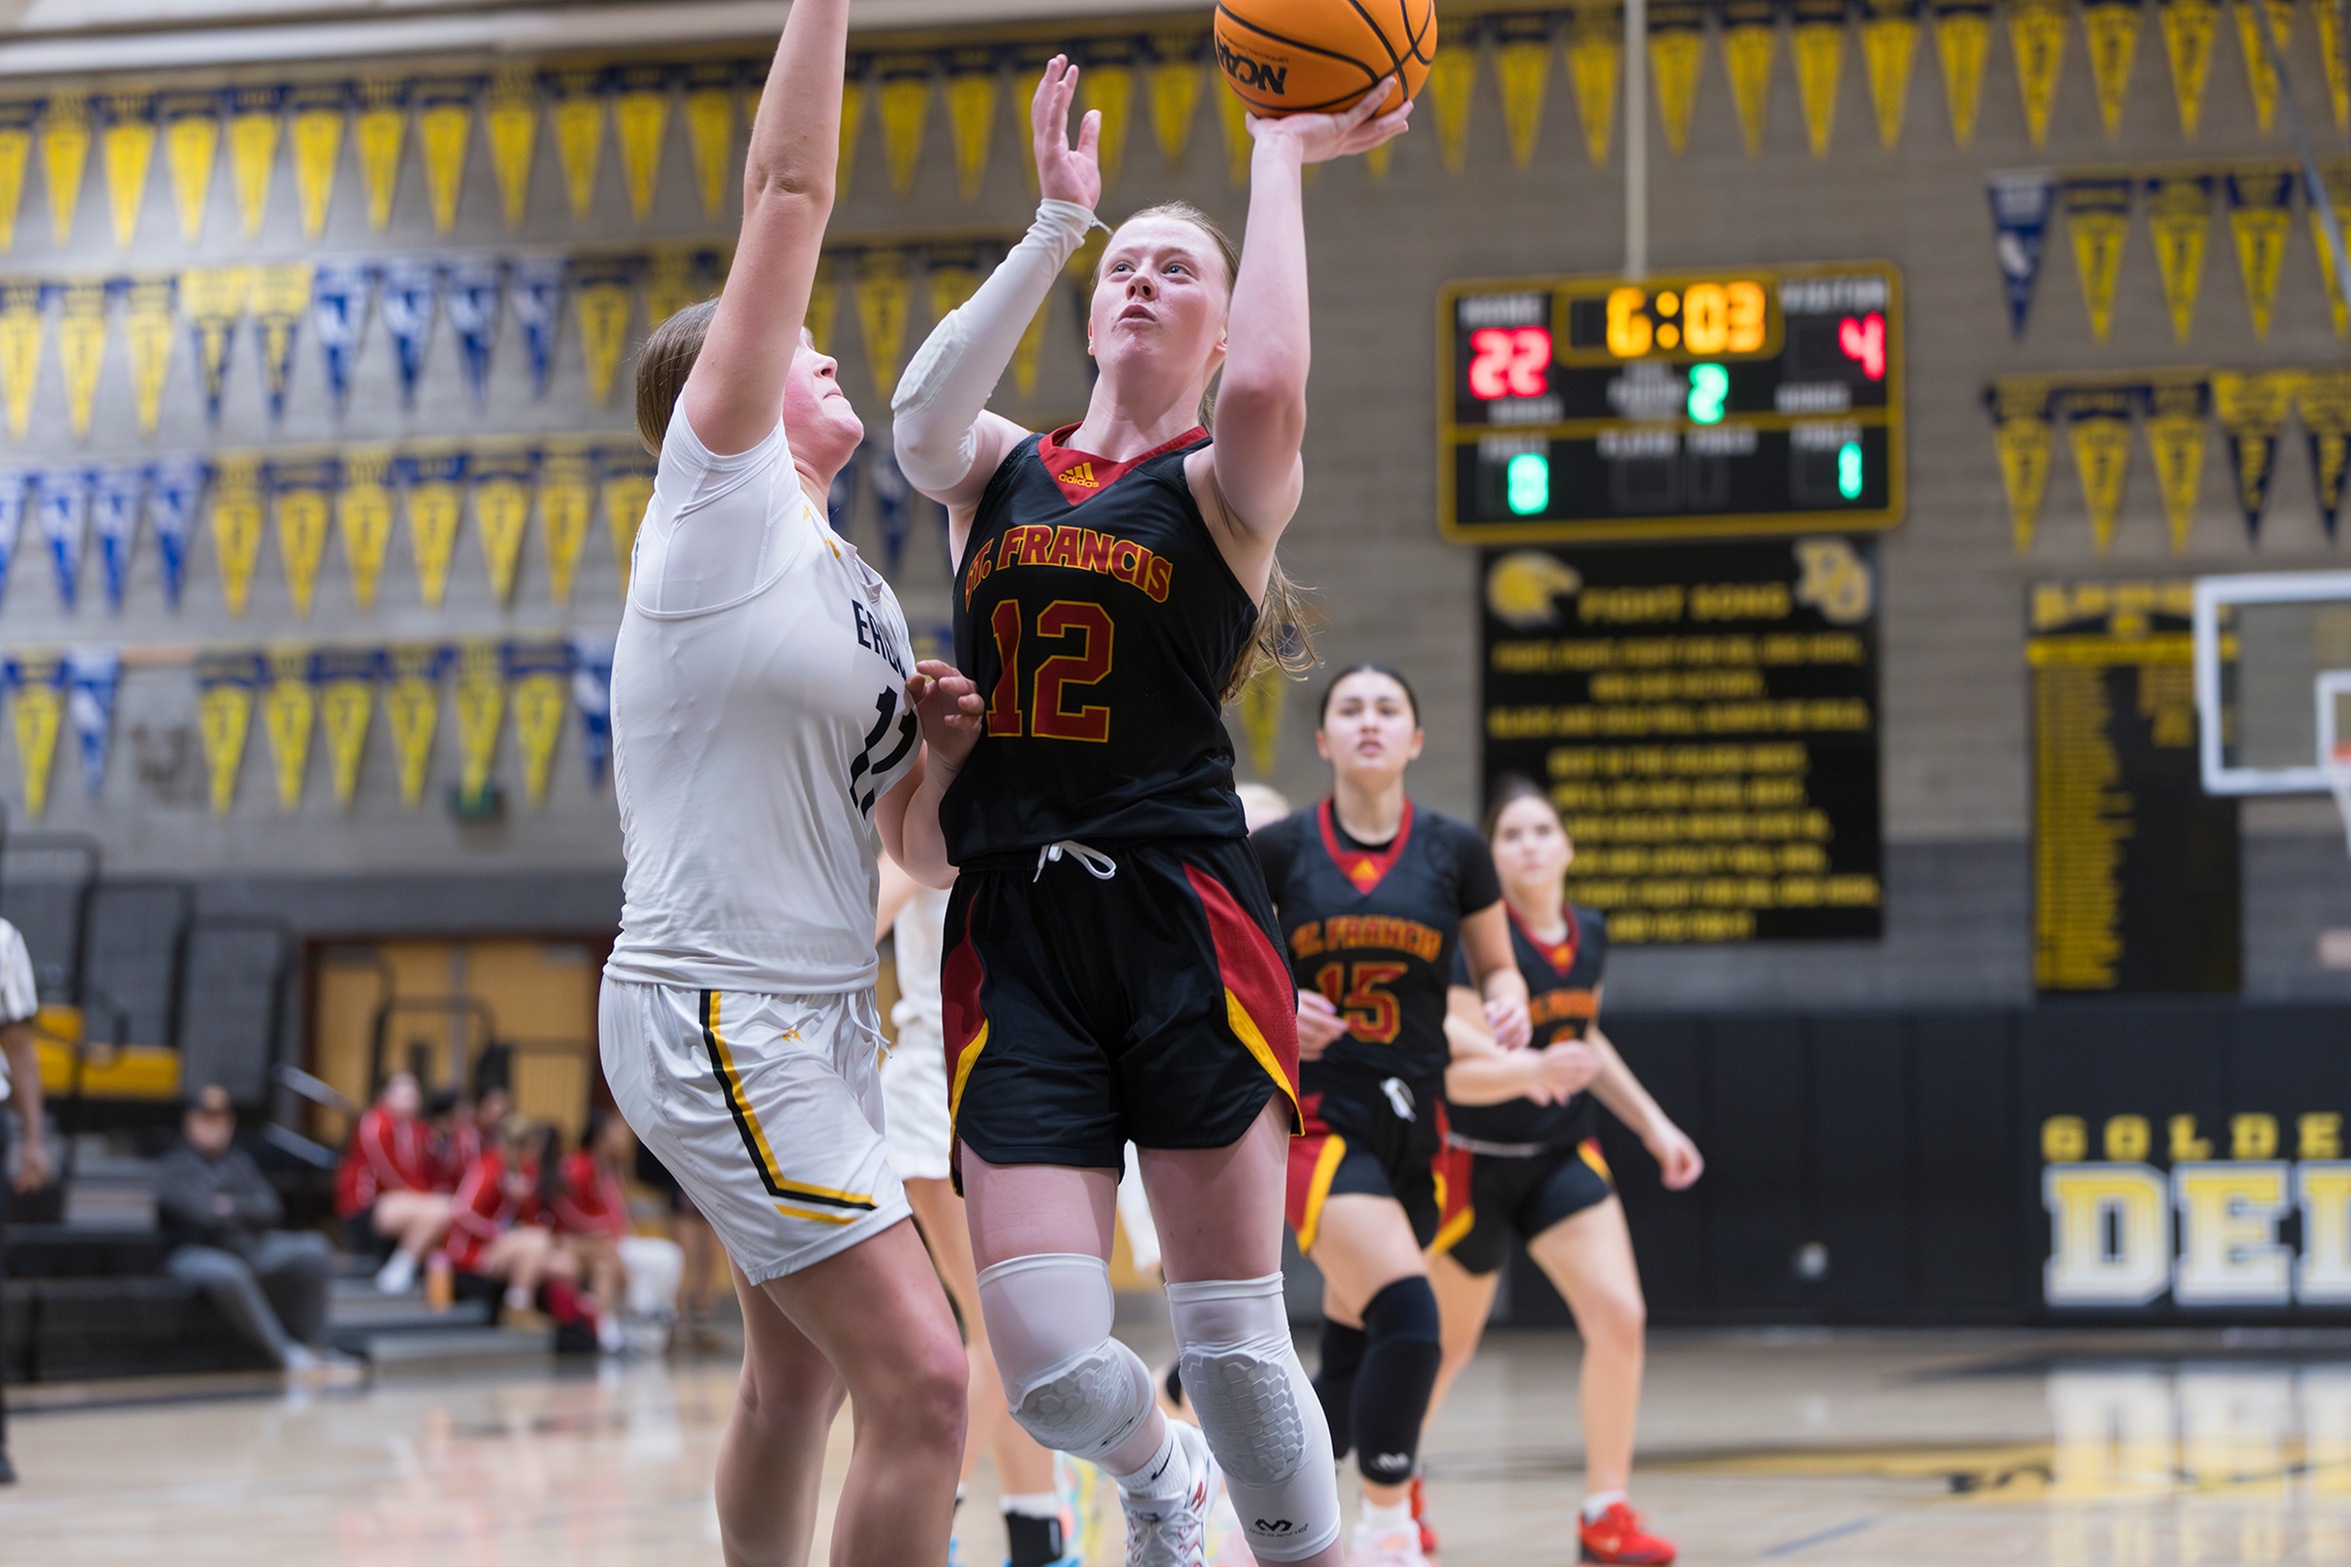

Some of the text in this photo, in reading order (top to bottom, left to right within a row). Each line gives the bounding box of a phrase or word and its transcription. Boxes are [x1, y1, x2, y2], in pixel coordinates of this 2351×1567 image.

[1607, 281, 1766, 358] 6:03
[1838, 311, 1886, 381] 4
[1468, 327, 1552, 399] 22
[1687, 362, 1729, 425] 2
[1058, 473, 1100, 488] adidas
[1837, 441, 1864, 500] 1
[996, 524, 1174, 604] FRANCIS
[986, 598, 1115, 743] 12
[1315, 962, 1409, 1045] 15
